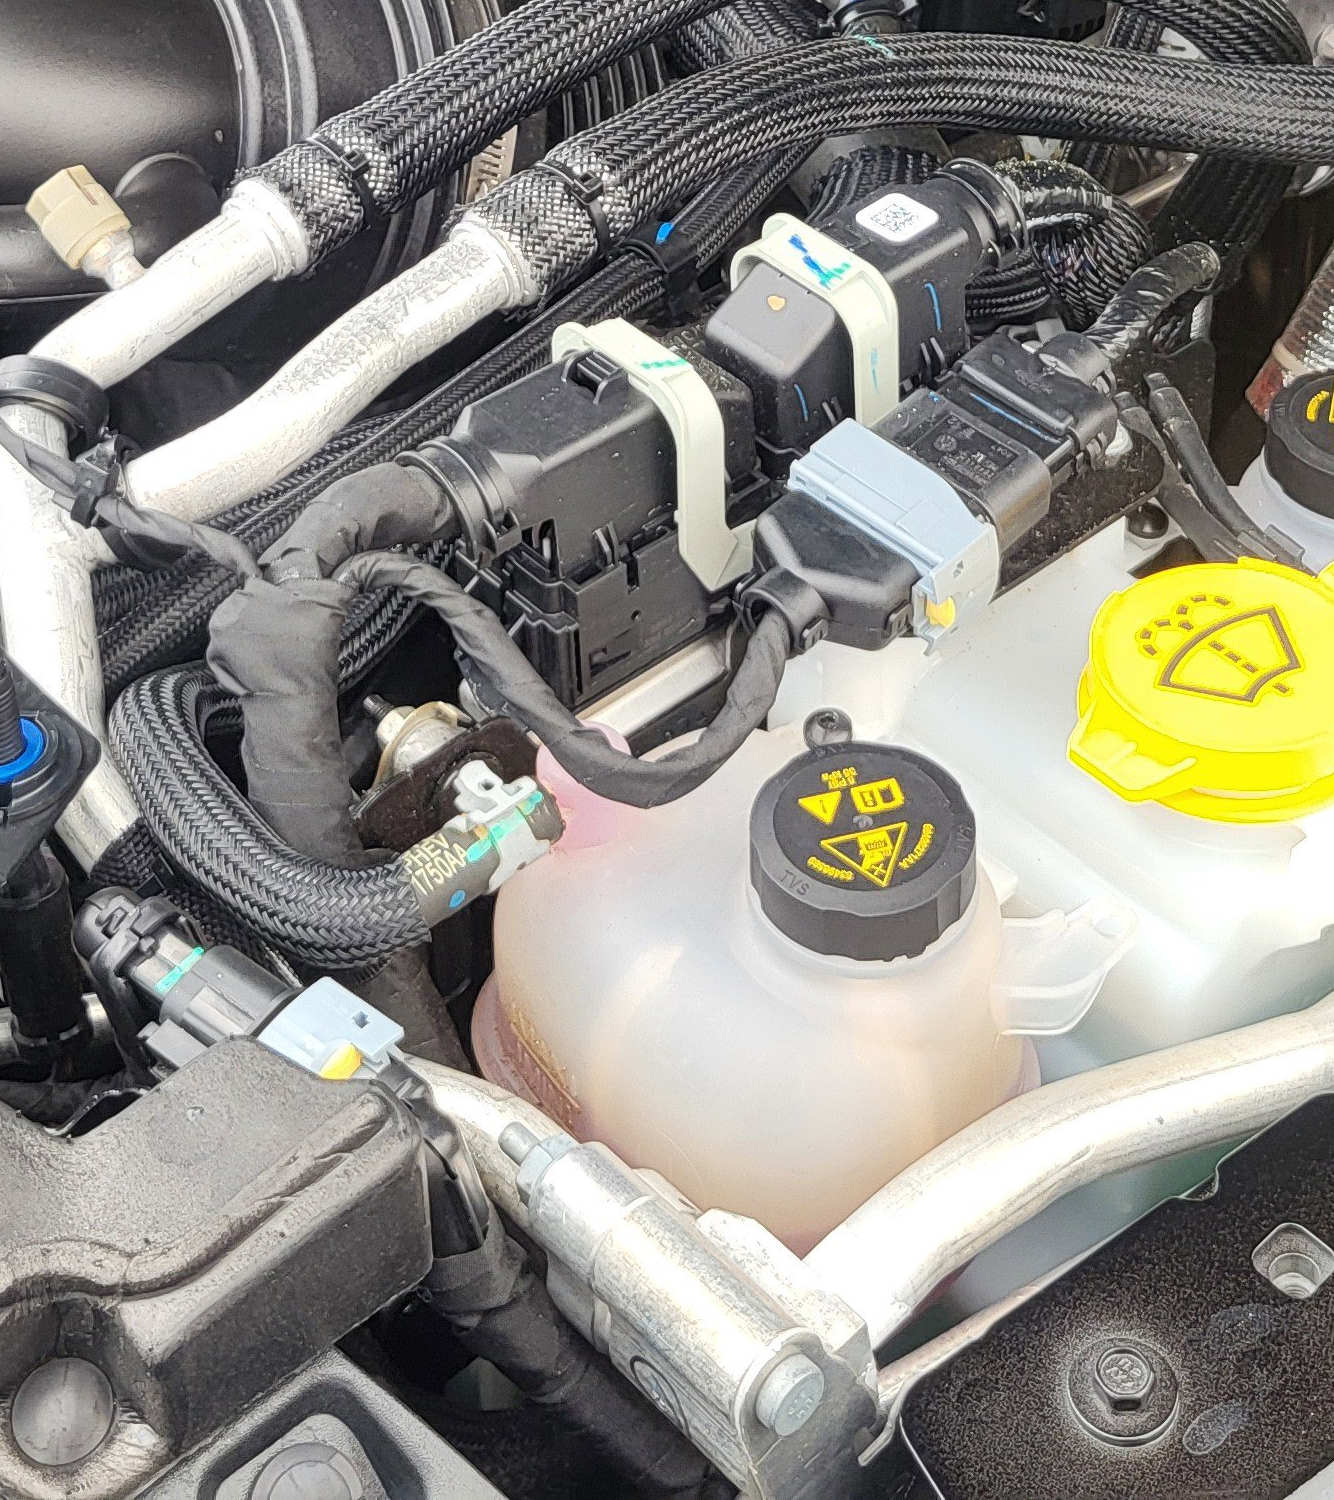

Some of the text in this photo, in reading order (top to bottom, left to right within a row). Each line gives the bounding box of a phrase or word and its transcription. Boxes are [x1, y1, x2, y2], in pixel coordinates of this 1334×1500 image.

[396, 829, 451, 875] PHEV
[405, 840, 474, 899] 1750AA
[777, 869, 809, 896] TVS
